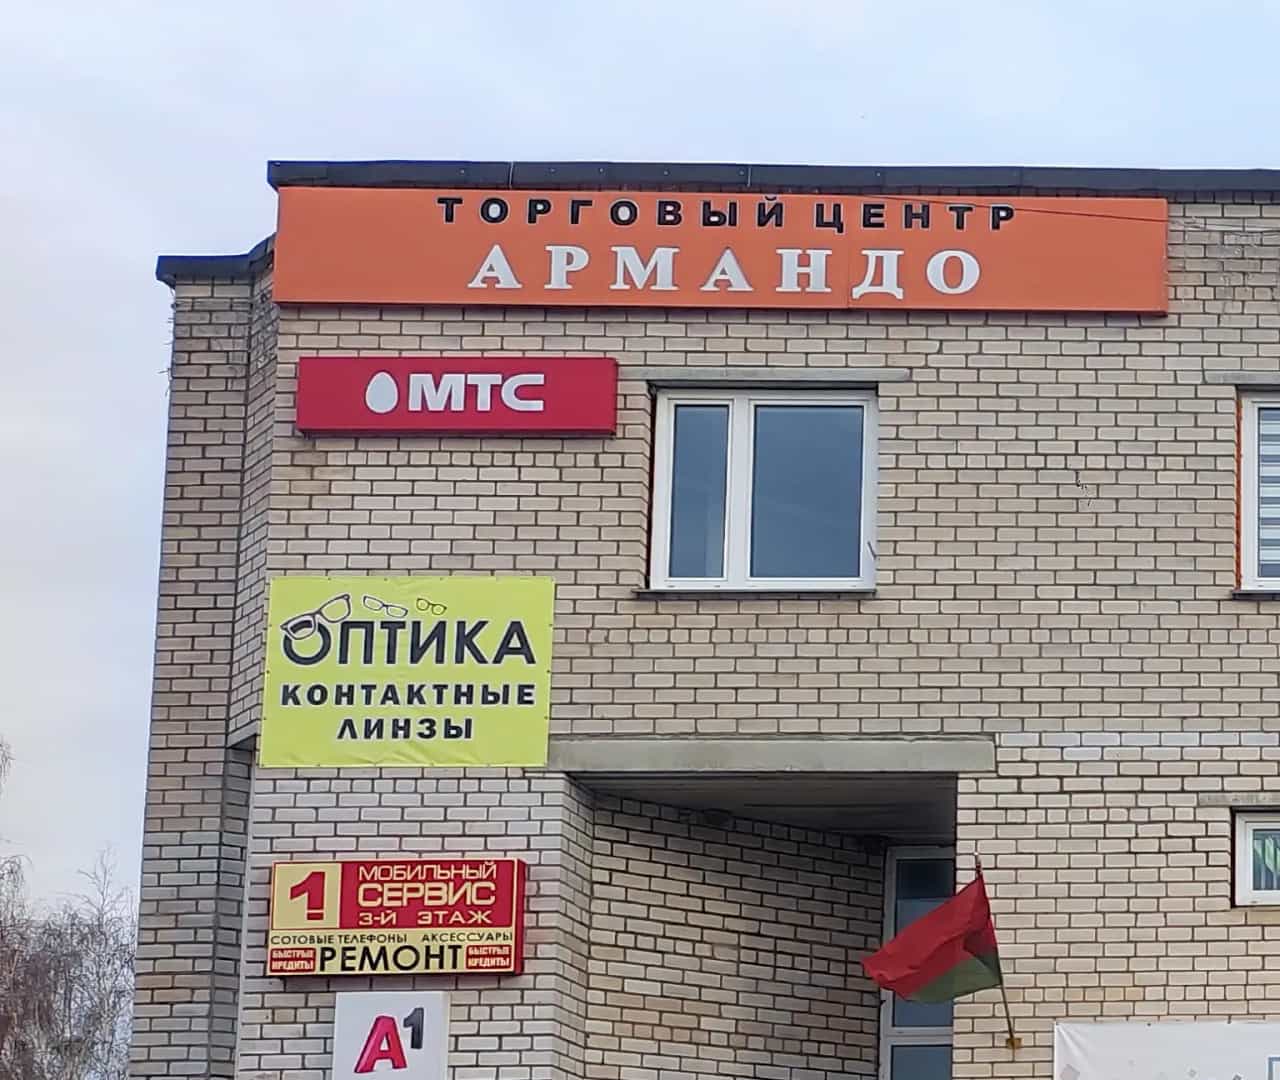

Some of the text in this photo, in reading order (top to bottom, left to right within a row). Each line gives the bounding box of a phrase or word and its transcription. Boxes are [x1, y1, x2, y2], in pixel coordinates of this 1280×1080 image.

[437, 194, 1017, 233] ТОРГОВЫЙ ЦЕНТР
[467, 243, 982, 301] АРМАНДО
[408, 372, 546, 412] МТС
[281, 618, 537, 667] ОПТИКА
[280, 683, 536, 707] КОНТАКТНЫЕ
[336, 717, 473, 740] ЛИНЗЫ
[358, 861, 497, 881] МОБИЛЬНЫЙ
[357, 882, 496, 907] СЕРВИС
[358, 909, 492, 925] 3-Й ЭТАЖ
[270, 931, 513, 946] СОТОВЫЕ ТЕЛЕФОНЫ АКСЕССУАРЫ
[319, 944, 463, 972] РЕМОНТ
